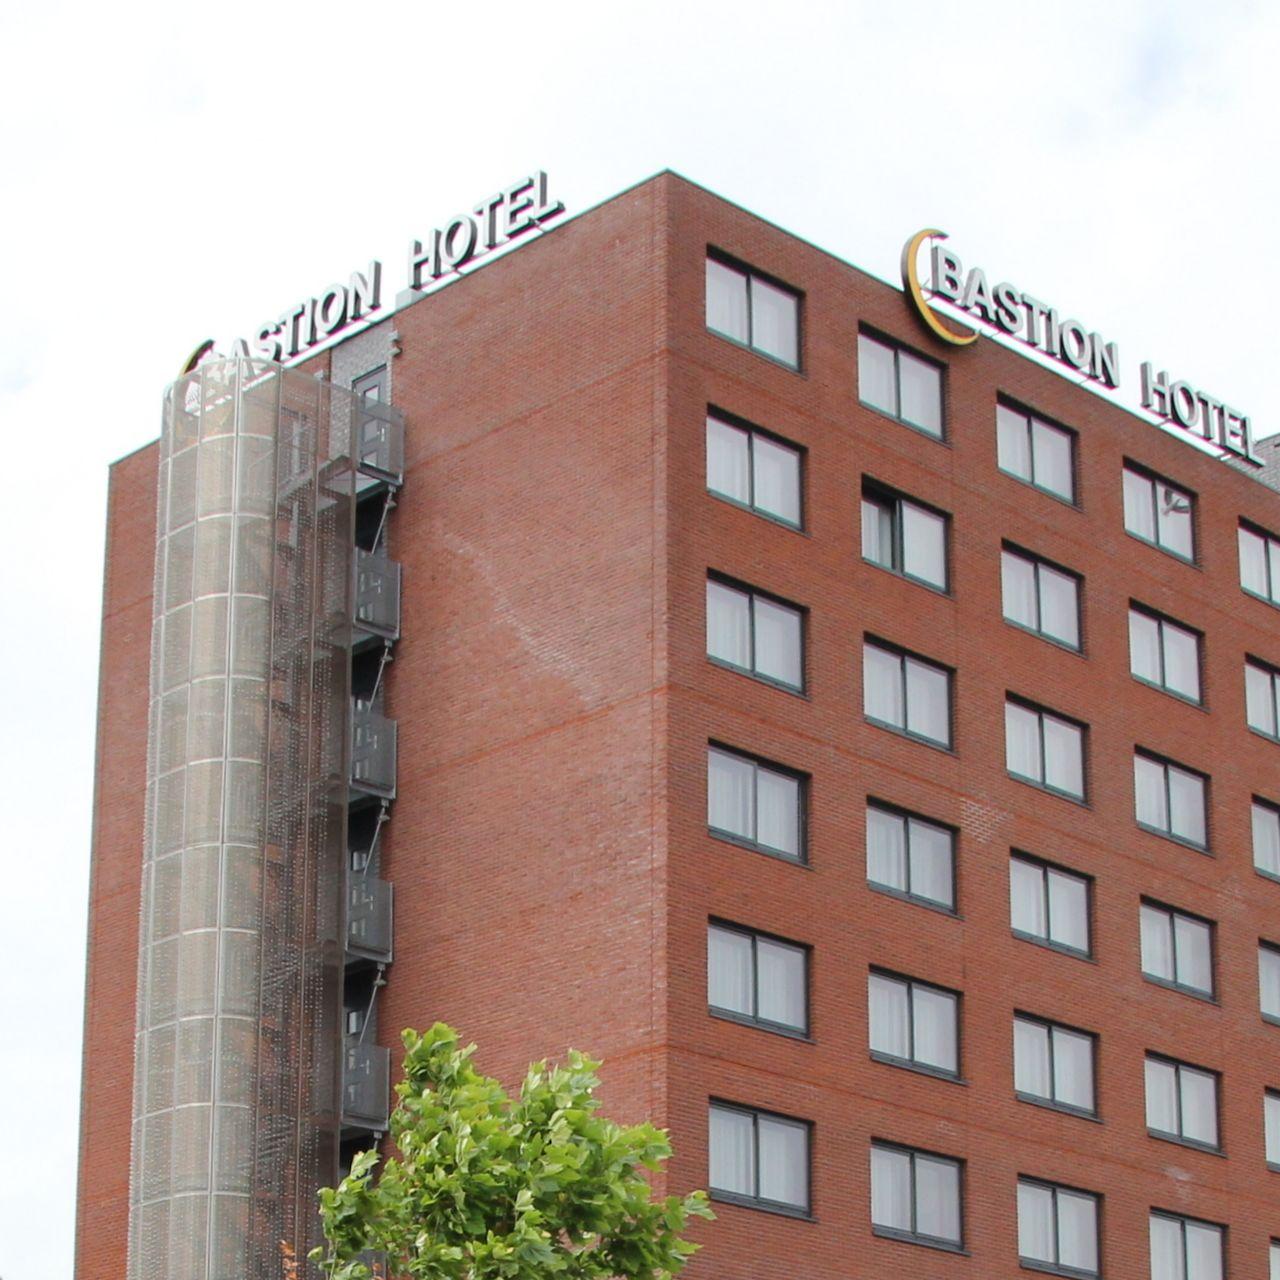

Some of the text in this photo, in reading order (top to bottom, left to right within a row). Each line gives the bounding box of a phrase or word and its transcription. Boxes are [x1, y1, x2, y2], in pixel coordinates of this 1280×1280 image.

[408, 170, 565, 291] HOTEL
[931, 245, 1266, 467] BASTION HOTEL
